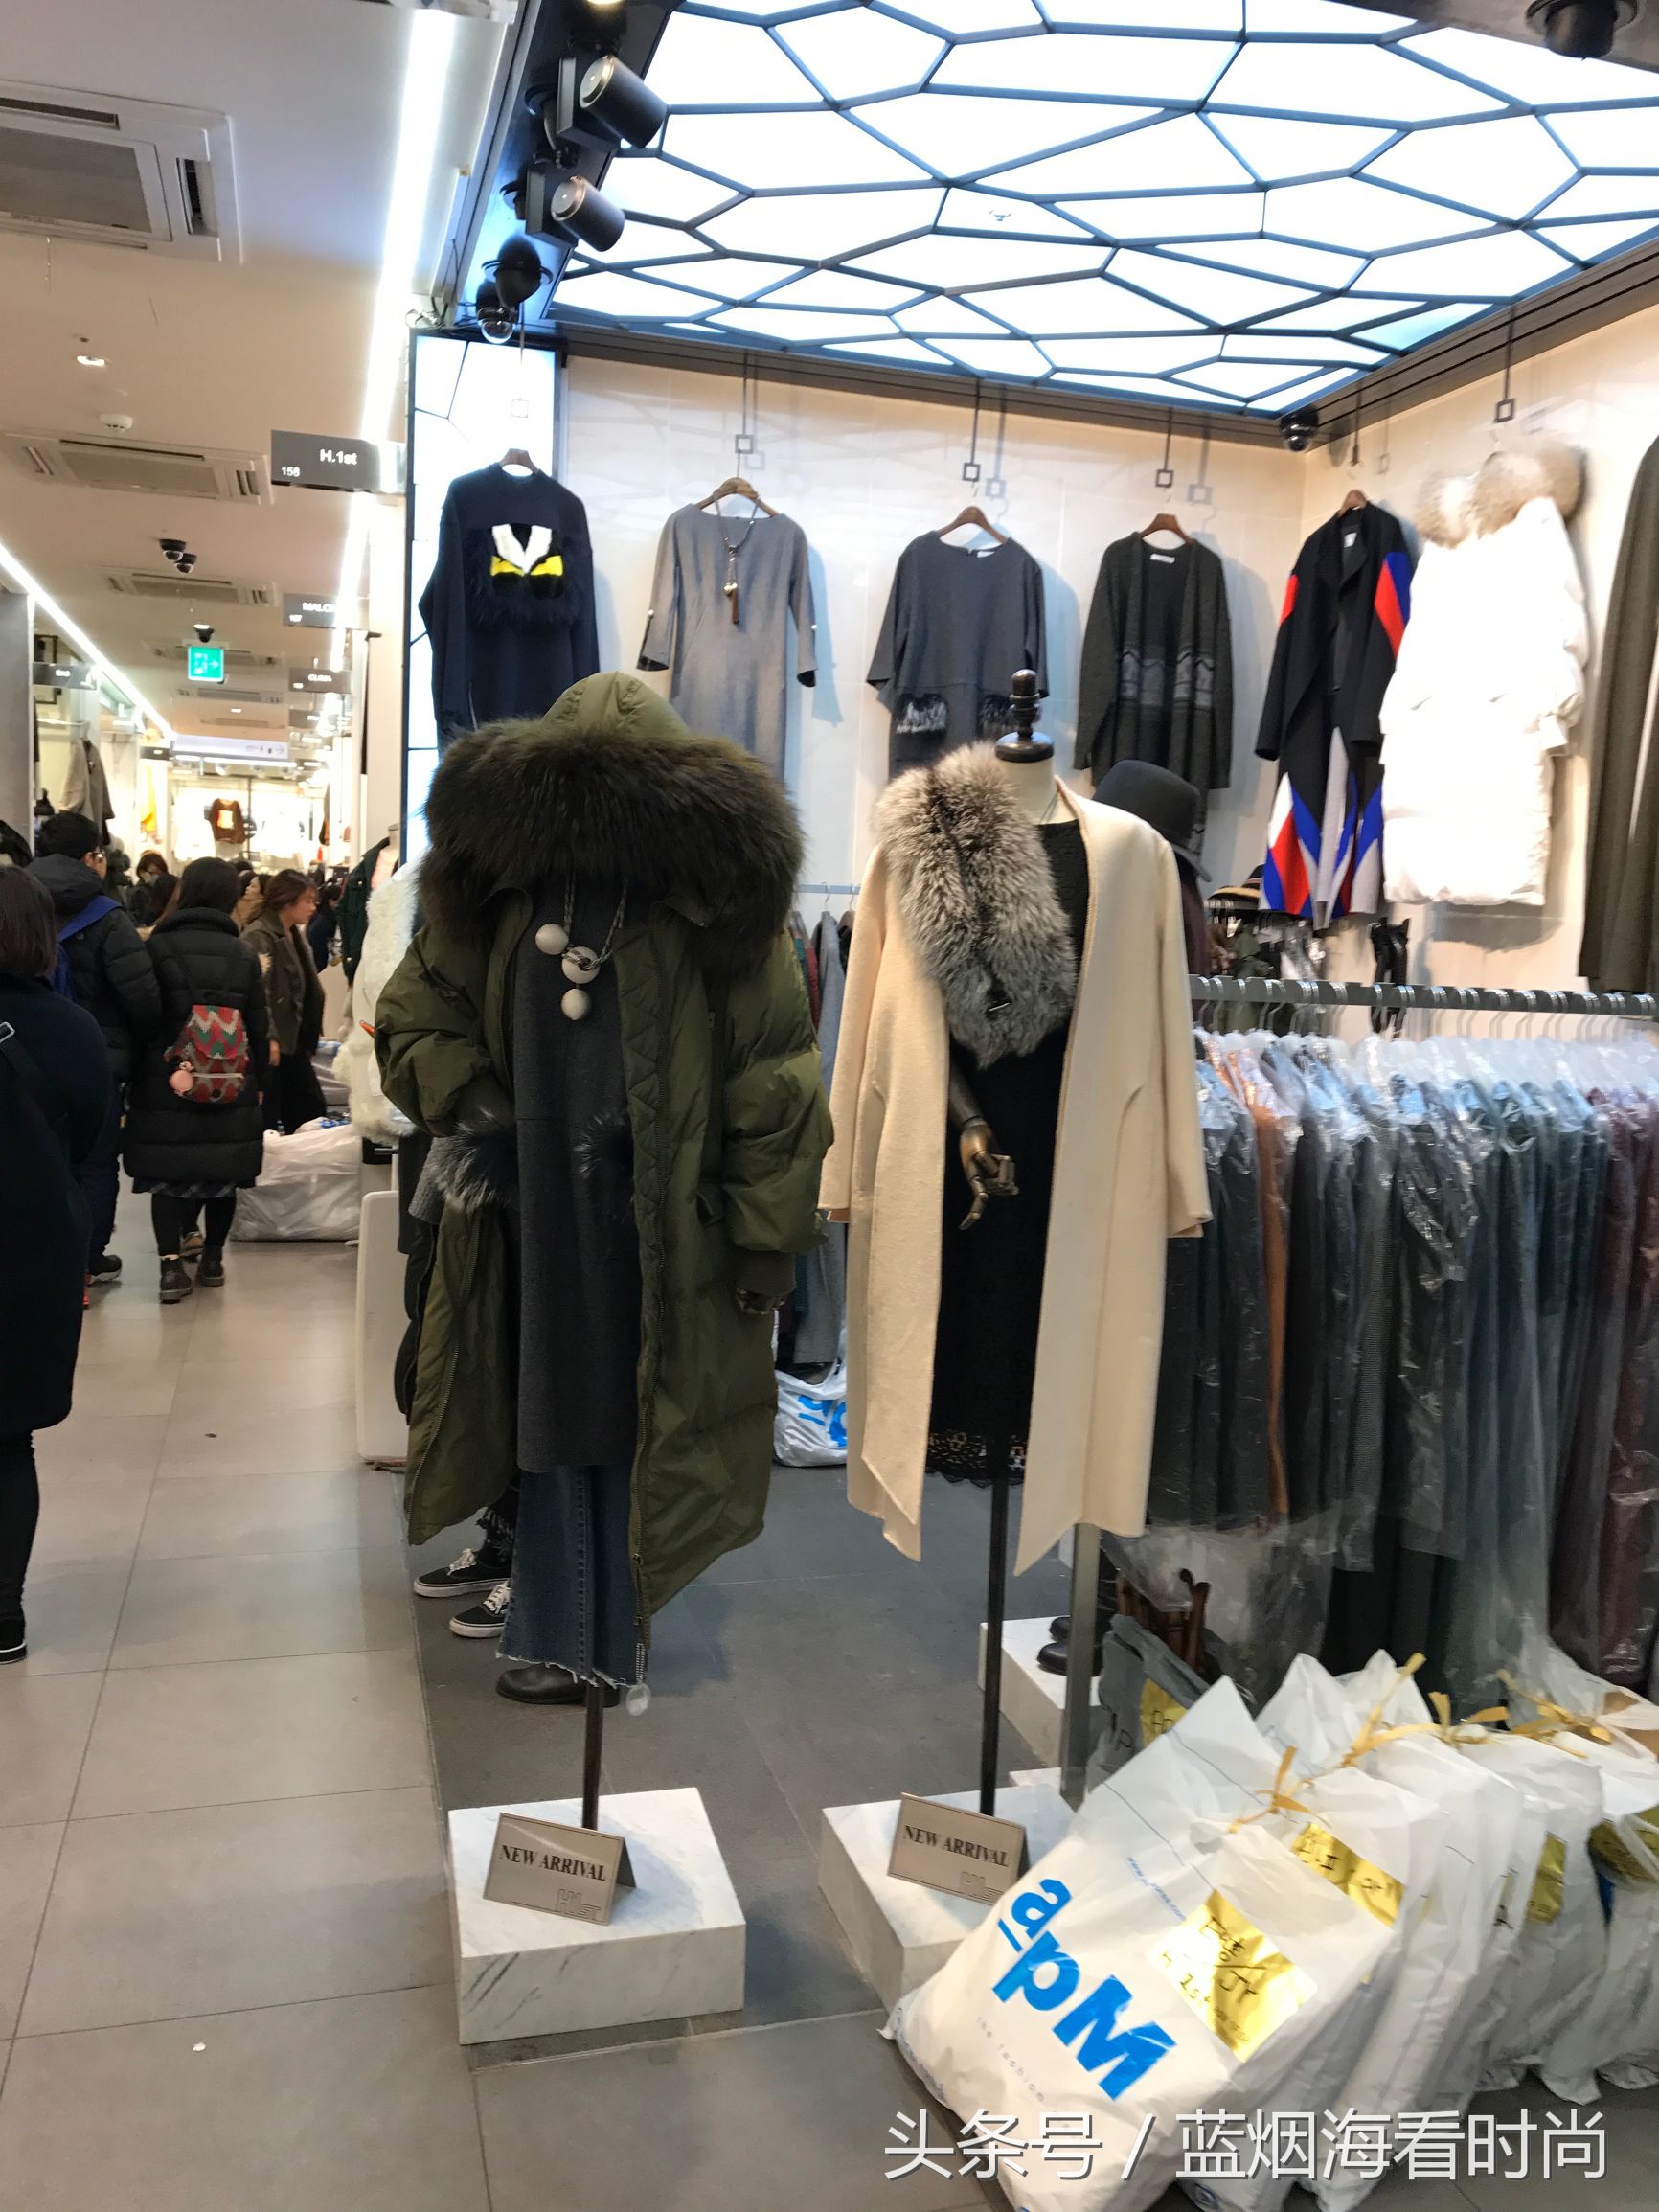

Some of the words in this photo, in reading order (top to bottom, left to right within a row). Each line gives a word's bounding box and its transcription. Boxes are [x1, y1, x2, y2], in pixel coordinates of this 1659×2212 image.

[319, 448, 358, 466] H.1st
[281, 466, 301, 478] 158
[902, 1825, 941, 1847] NEW
[943, 1836, 1009, 1867] ARRIVAL
[500, 1844, 538, 1865] NEW
[538, 1855, 606, 1881] ARRIVAL
